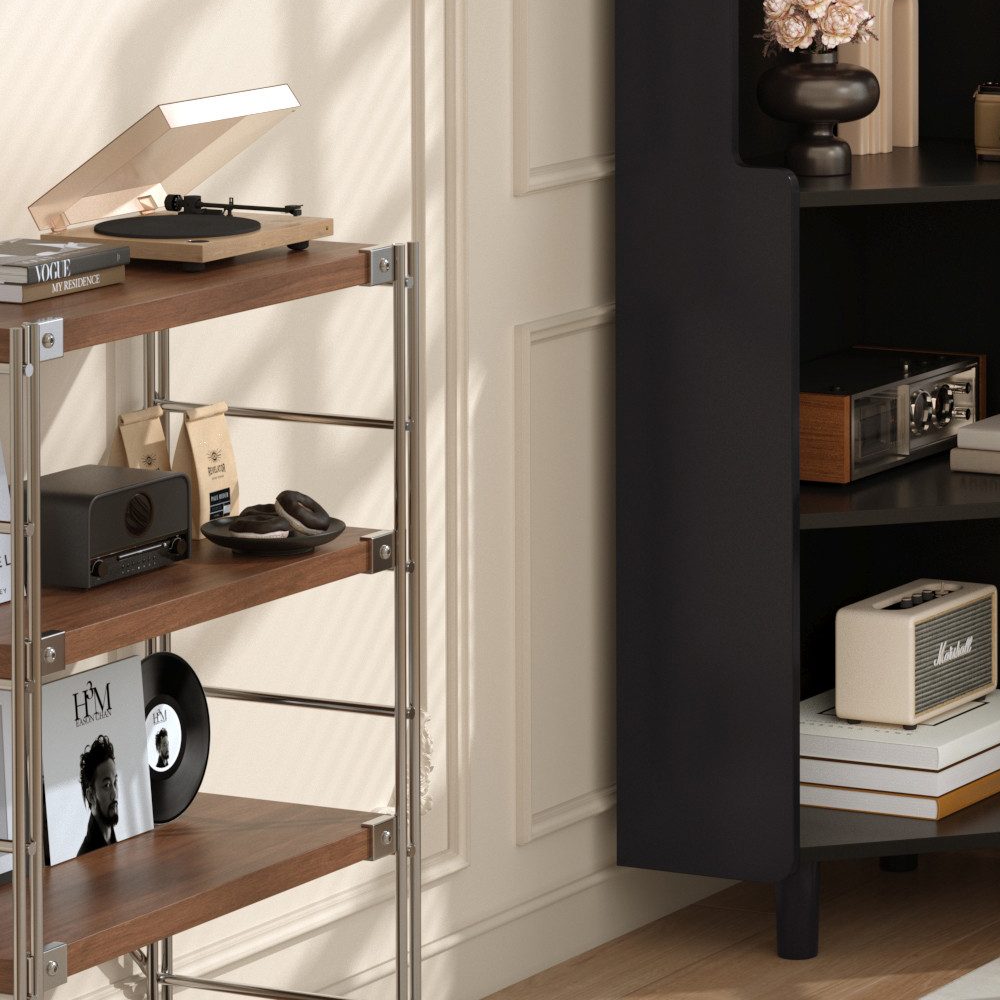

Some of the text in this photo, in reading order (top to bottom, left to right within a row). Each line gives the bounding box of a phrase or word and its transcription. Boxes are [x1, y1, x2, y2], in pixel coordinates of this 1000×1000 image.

[35, 258, 71, 282] VOGUE
[51, 273, 101, 294] MY RESIDENCE
[933, 635, 974, 667] Marshall
[75, 708, 113, 728] EASON CHAN
